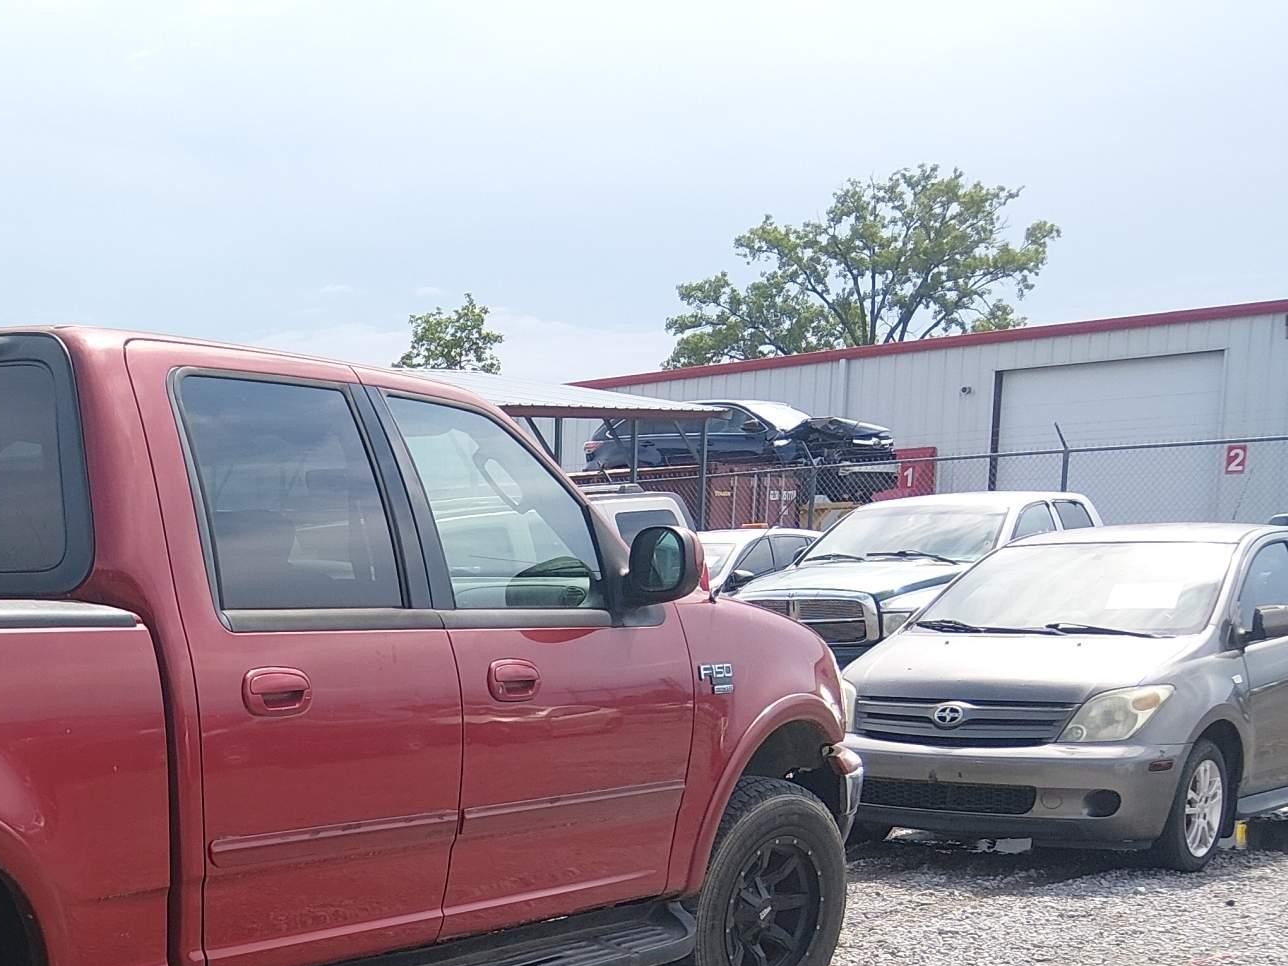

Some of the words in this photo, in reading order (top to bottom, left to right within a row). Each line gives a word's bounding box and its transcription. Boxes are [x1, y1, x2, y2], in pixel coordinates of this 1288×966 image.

[1227, 448, 1244, 471] 2
[903, 466, 913, 487] 1
[700, 663, 733, 680] F150
